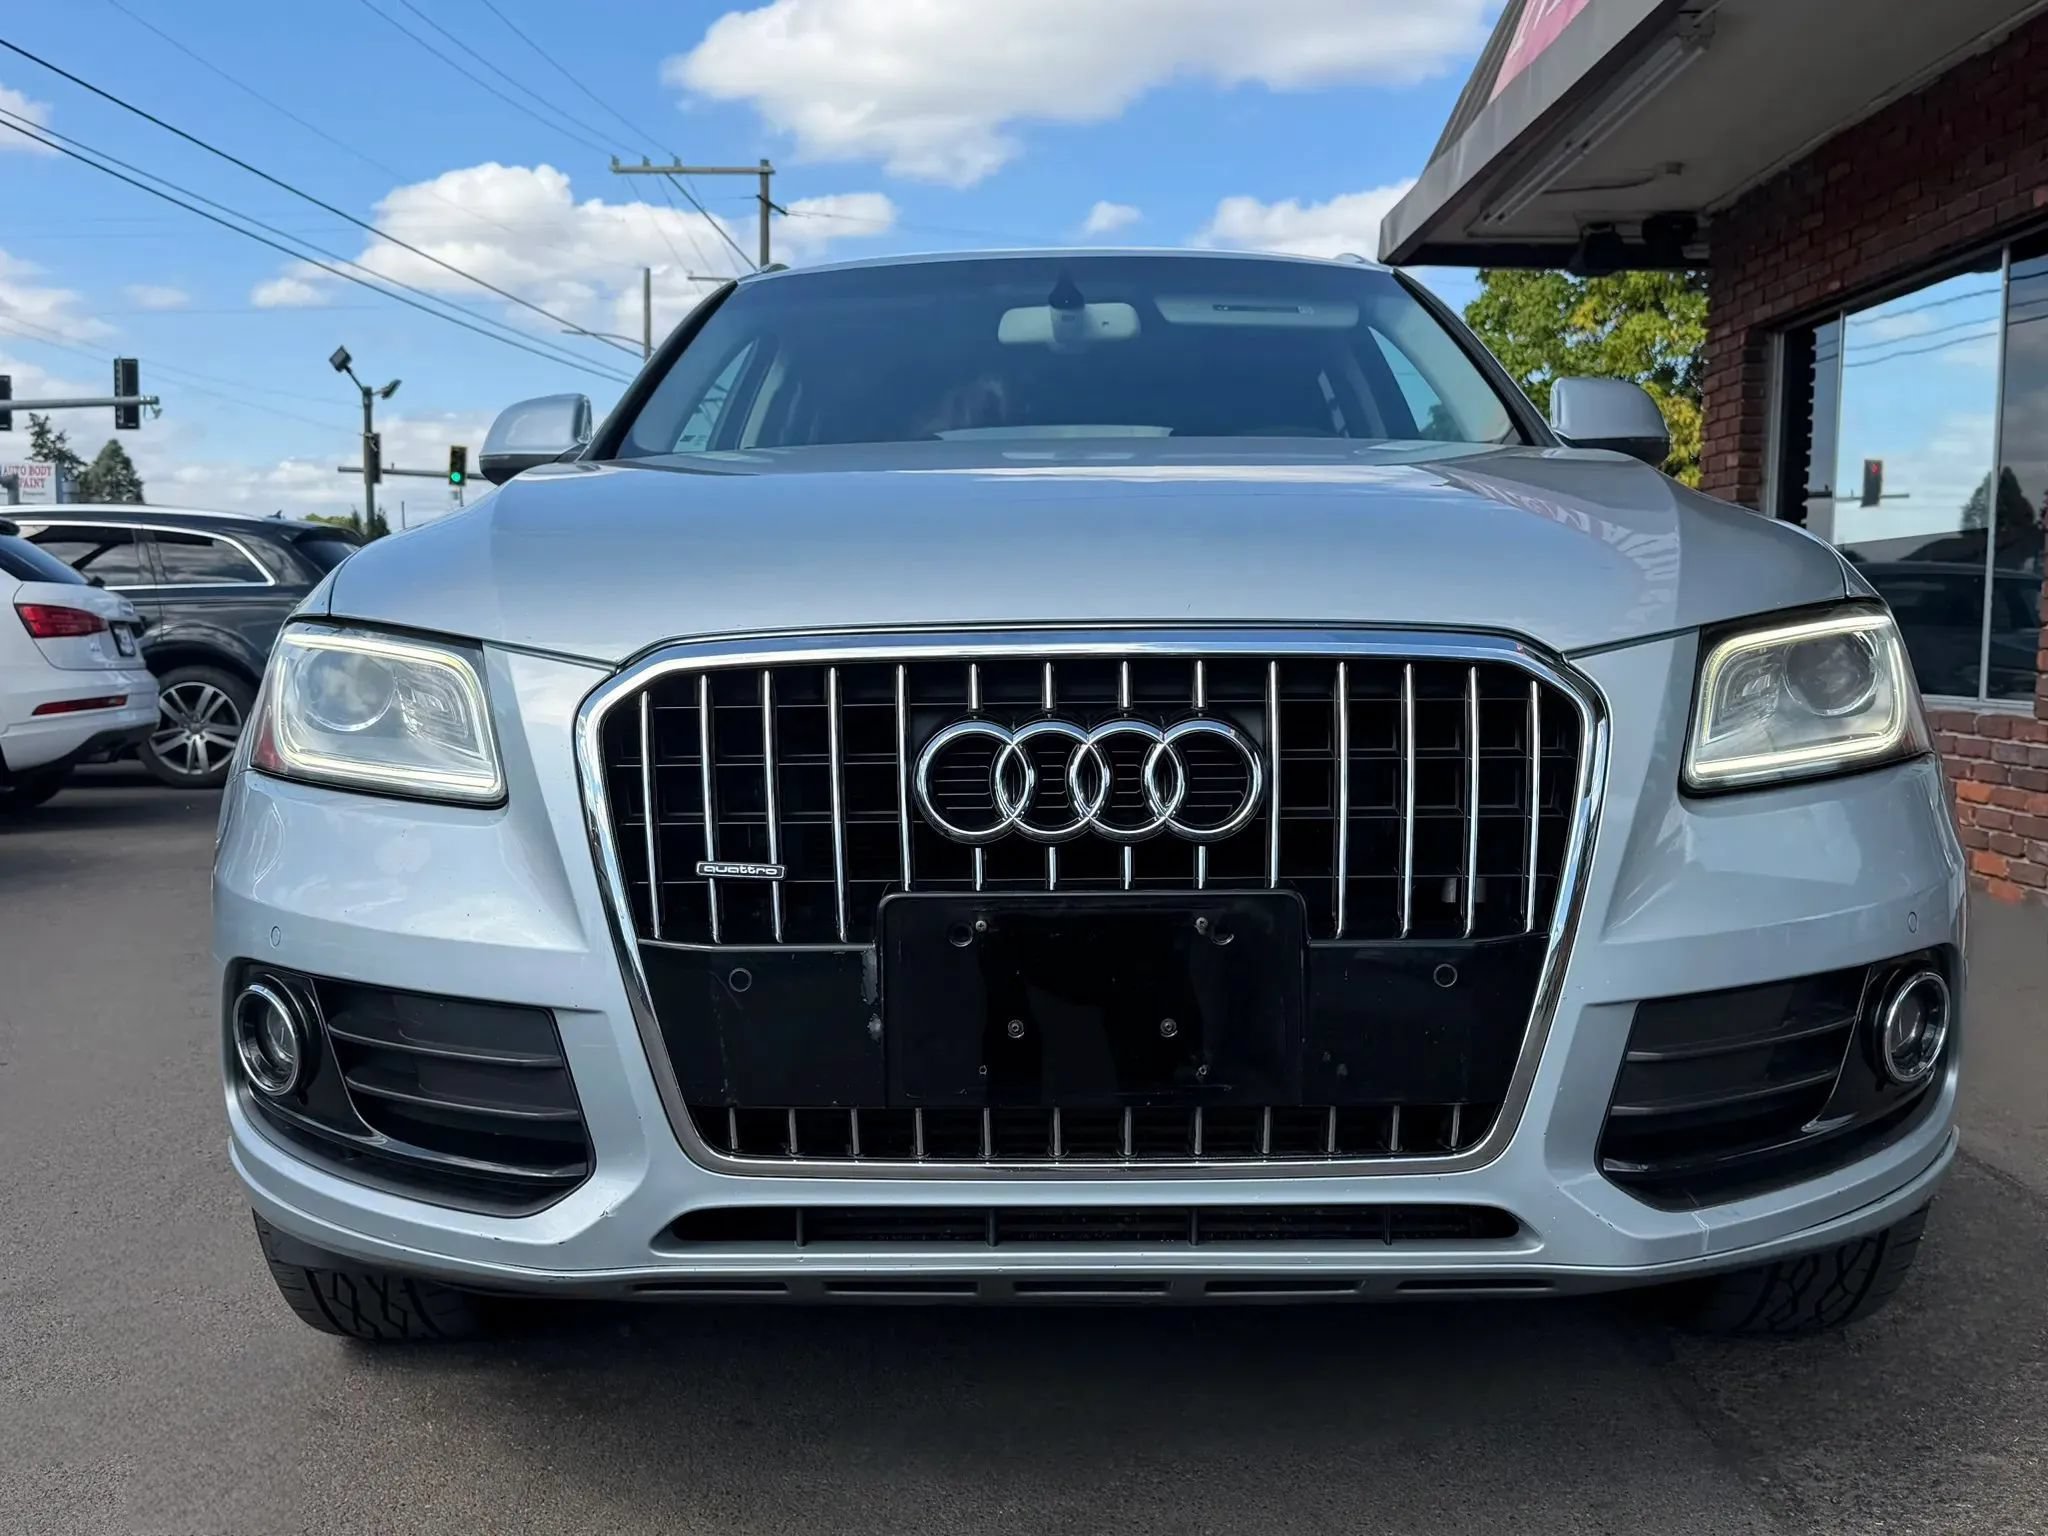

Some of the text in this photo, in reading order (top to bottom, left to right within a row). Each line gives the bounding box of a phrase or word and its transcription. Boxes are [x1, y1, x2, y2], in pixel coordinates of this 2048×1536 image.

[4, 465, 52, 476] AUTO BODY
[703, 865, 778, 875] quattro
